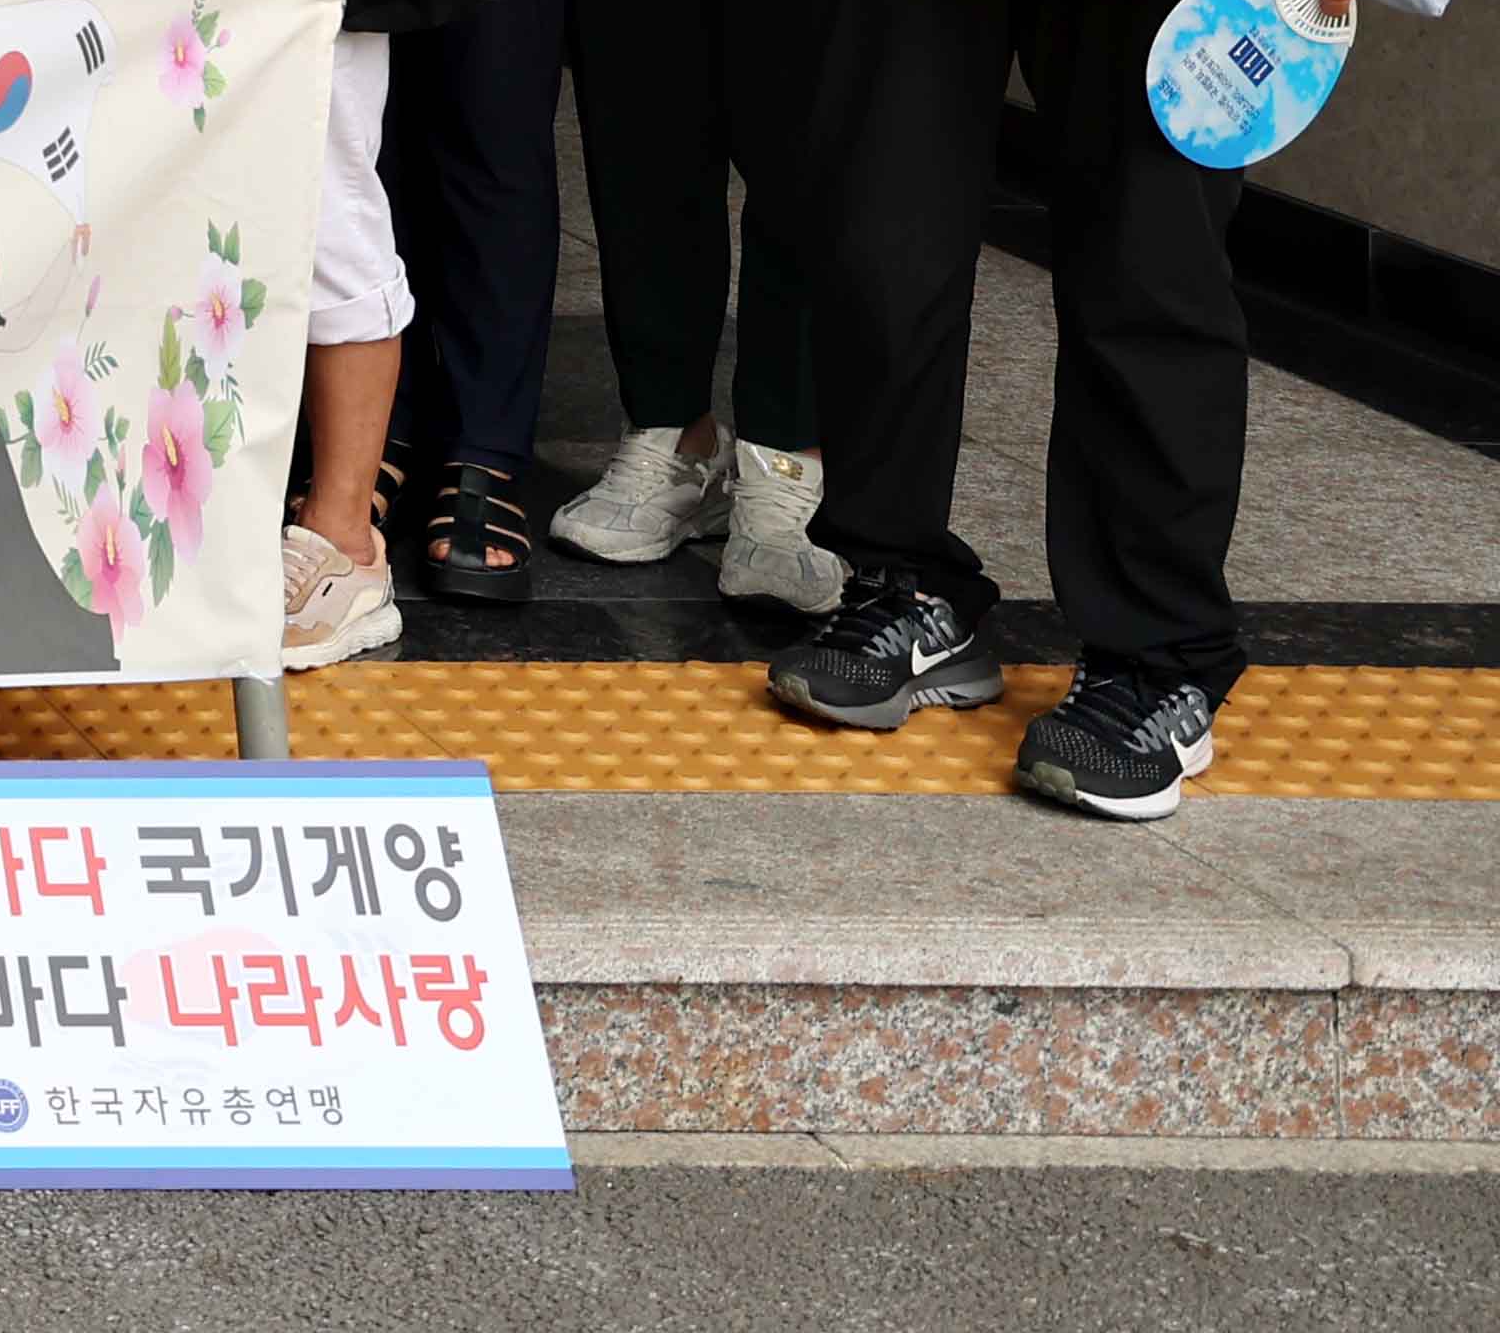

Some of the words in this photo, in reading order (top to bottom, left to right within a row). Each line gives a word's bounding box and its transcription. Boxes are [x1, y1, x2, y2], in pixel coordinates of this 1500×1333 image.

[1231, 36, 1272, 83] 111
[137, 822, 465, 923] 국기게양
[159, 953, 489, 1051] 나라사랑
[44, 1085, 344, 1127] 한국자유총연맹
